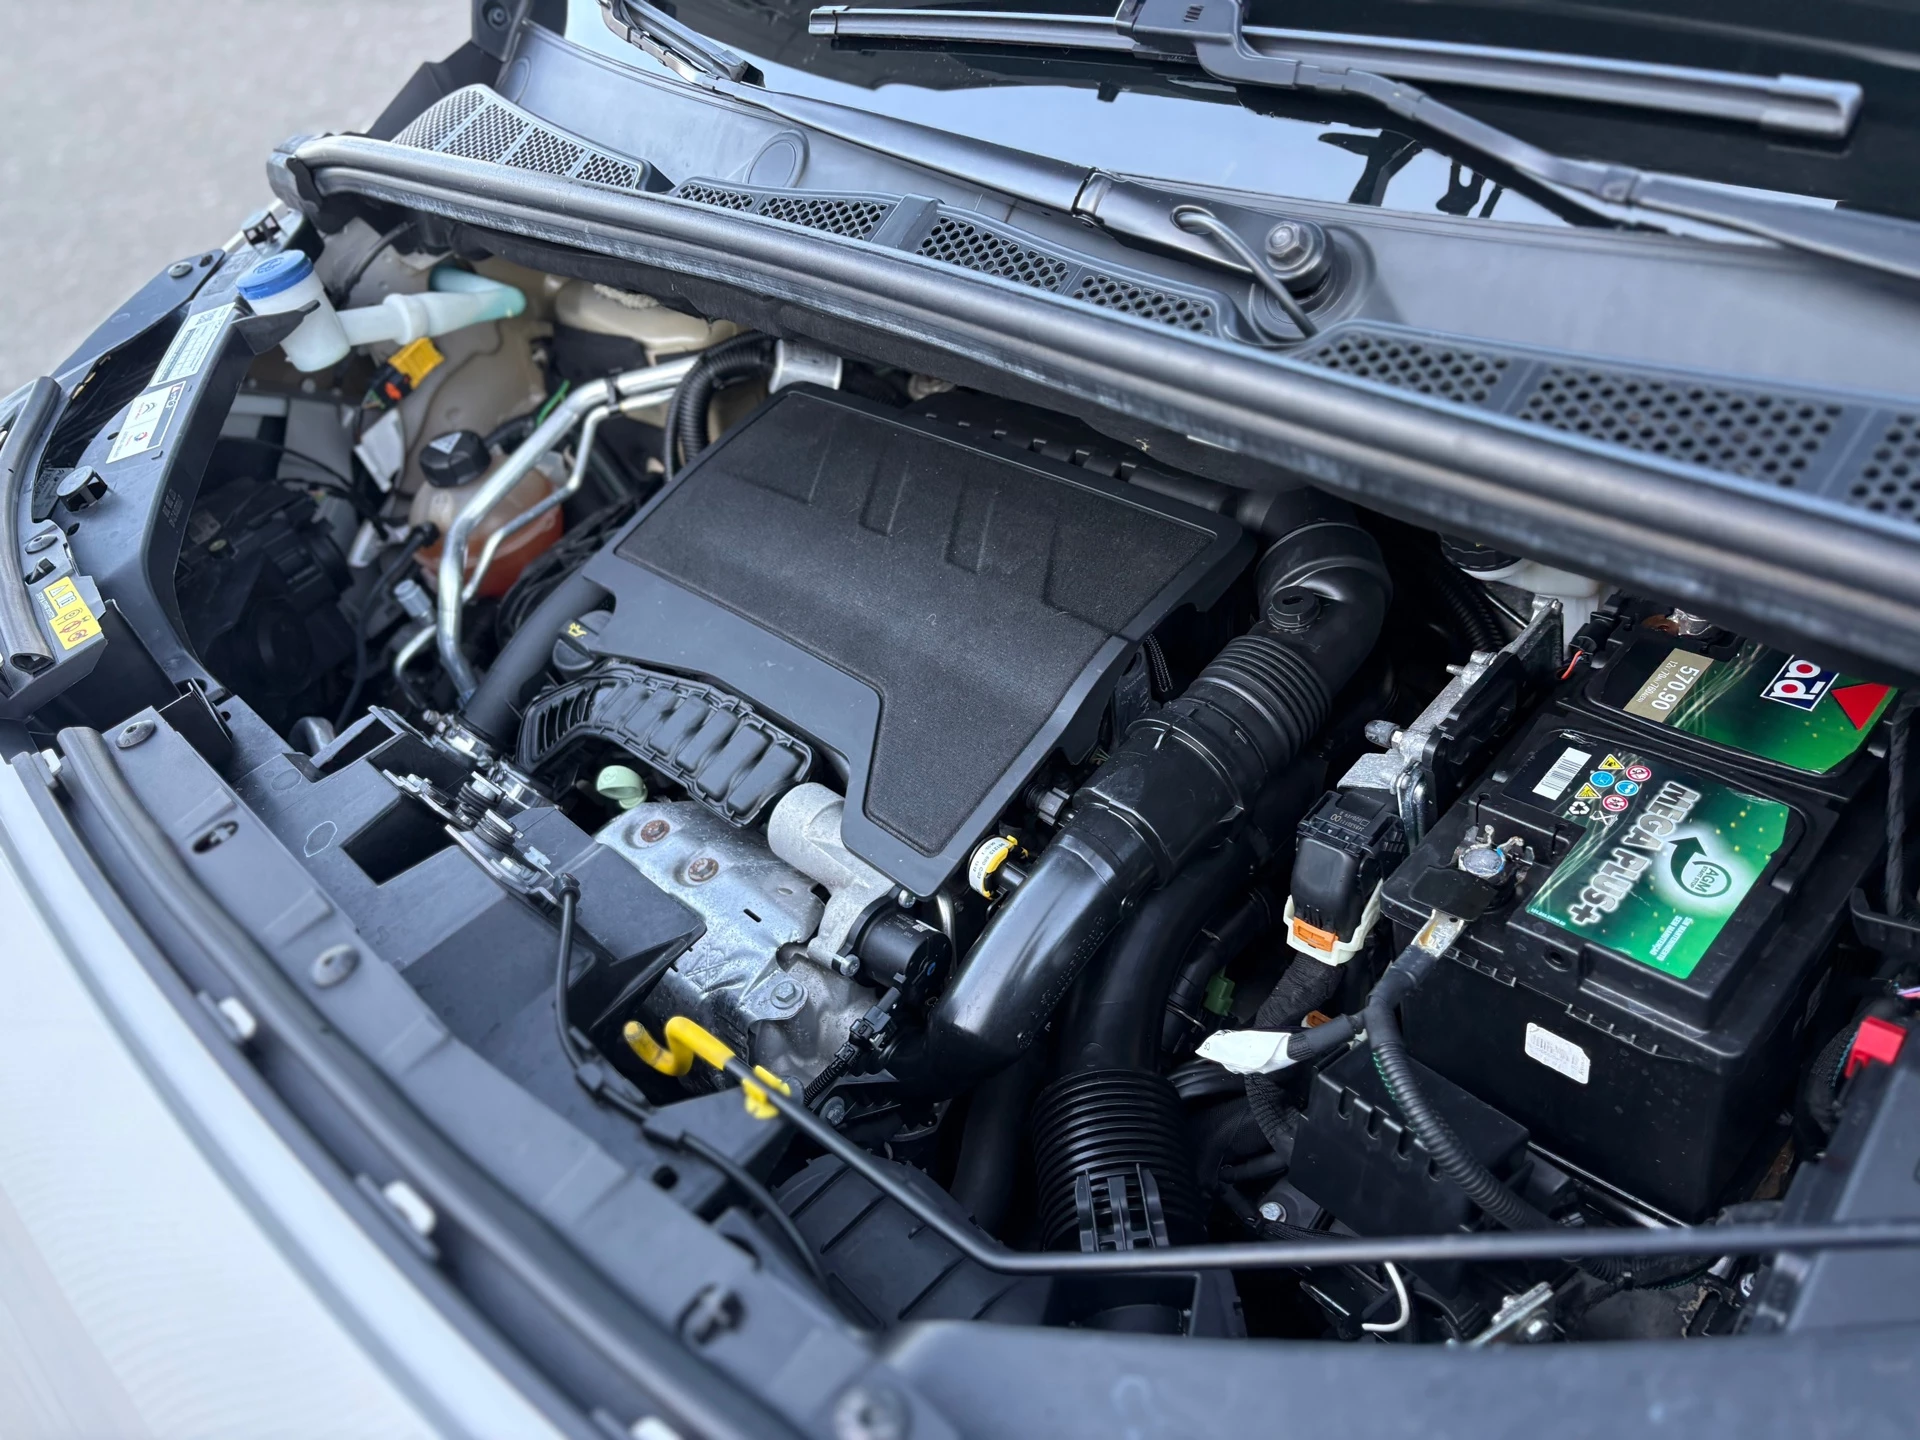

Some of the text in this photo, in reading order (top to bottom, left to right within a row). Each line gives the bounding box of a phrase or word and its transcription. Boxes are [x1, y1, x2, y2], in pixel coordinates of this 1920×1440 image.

[1651, 664, 1700, 712] 570.90
[1567, 781, 1701, 926] MEGA PLUS+
[1689, 865, 1709, 889] START STOP
[1694, 867, 1720, 894] AGM
